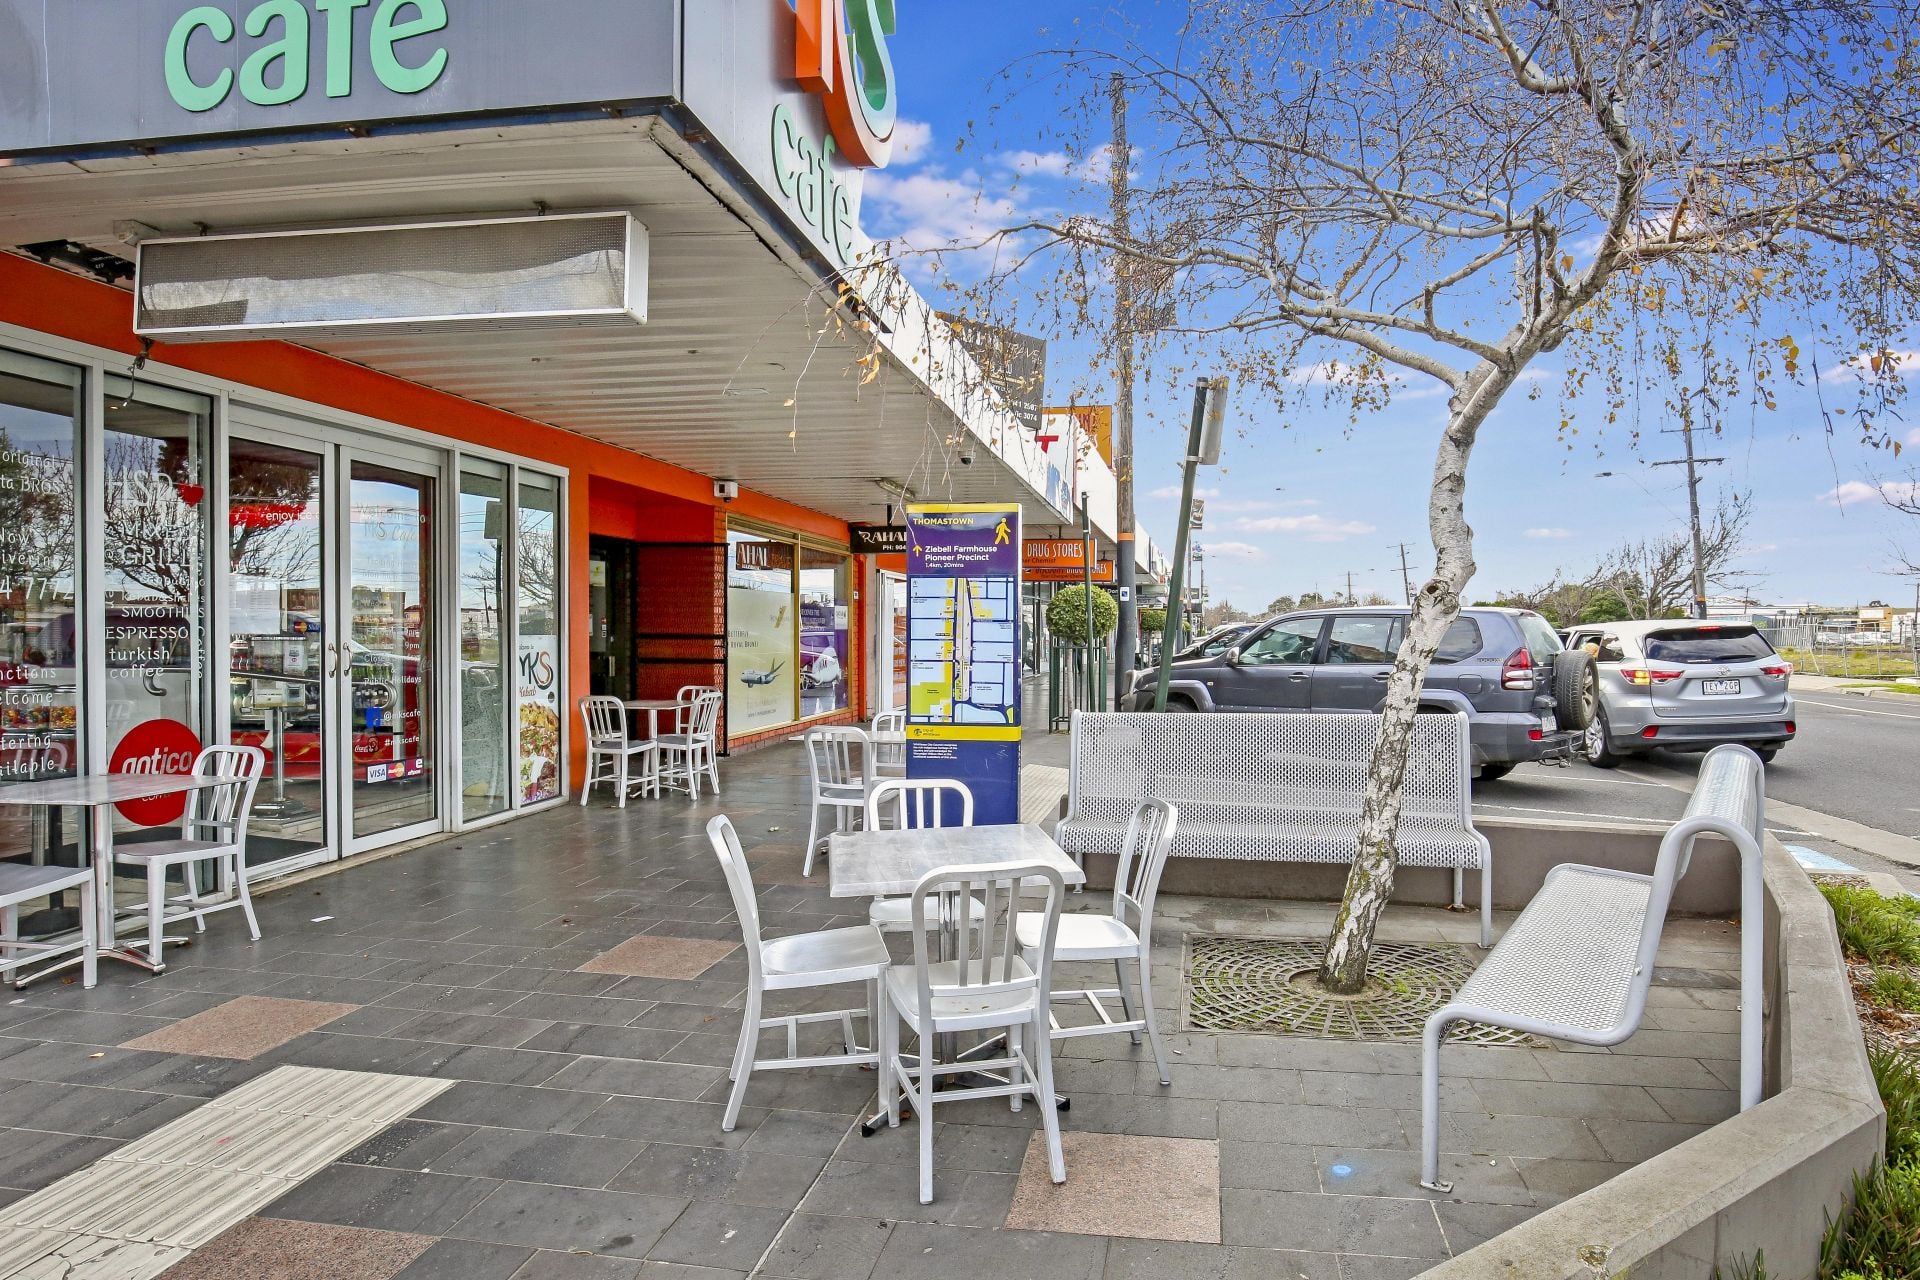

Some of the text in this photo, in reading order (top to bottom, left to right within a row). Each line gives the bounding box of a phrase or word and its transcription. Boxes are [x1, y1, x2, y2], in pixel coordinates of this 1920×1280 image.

[771, 103, 852, 265] Cafe
[2, 450, 56, 470] original
[20, 477, 61, 495] BROS
[265, 511, 294, 523] enjoy
[121, 545, 193, 568] GRILL
[1027, 543, 1083, 558] DRUG STORES
[22, 577, 75, 600] 7772
[121, 606, 206, 619] SMOOTHIS
[105, 626, 189, 640] ESPRESSO
[108, 646, 171, 661] turkish
[404, 641, 420, 651] 9pm
[110, 663, 164, 679] coffee
[383, 709, 422, 721] @mkscafe
[1, 734, 52, 750] tering
[121, 747, 193, 776] antico
[369, 768, 386, 778] VISA
